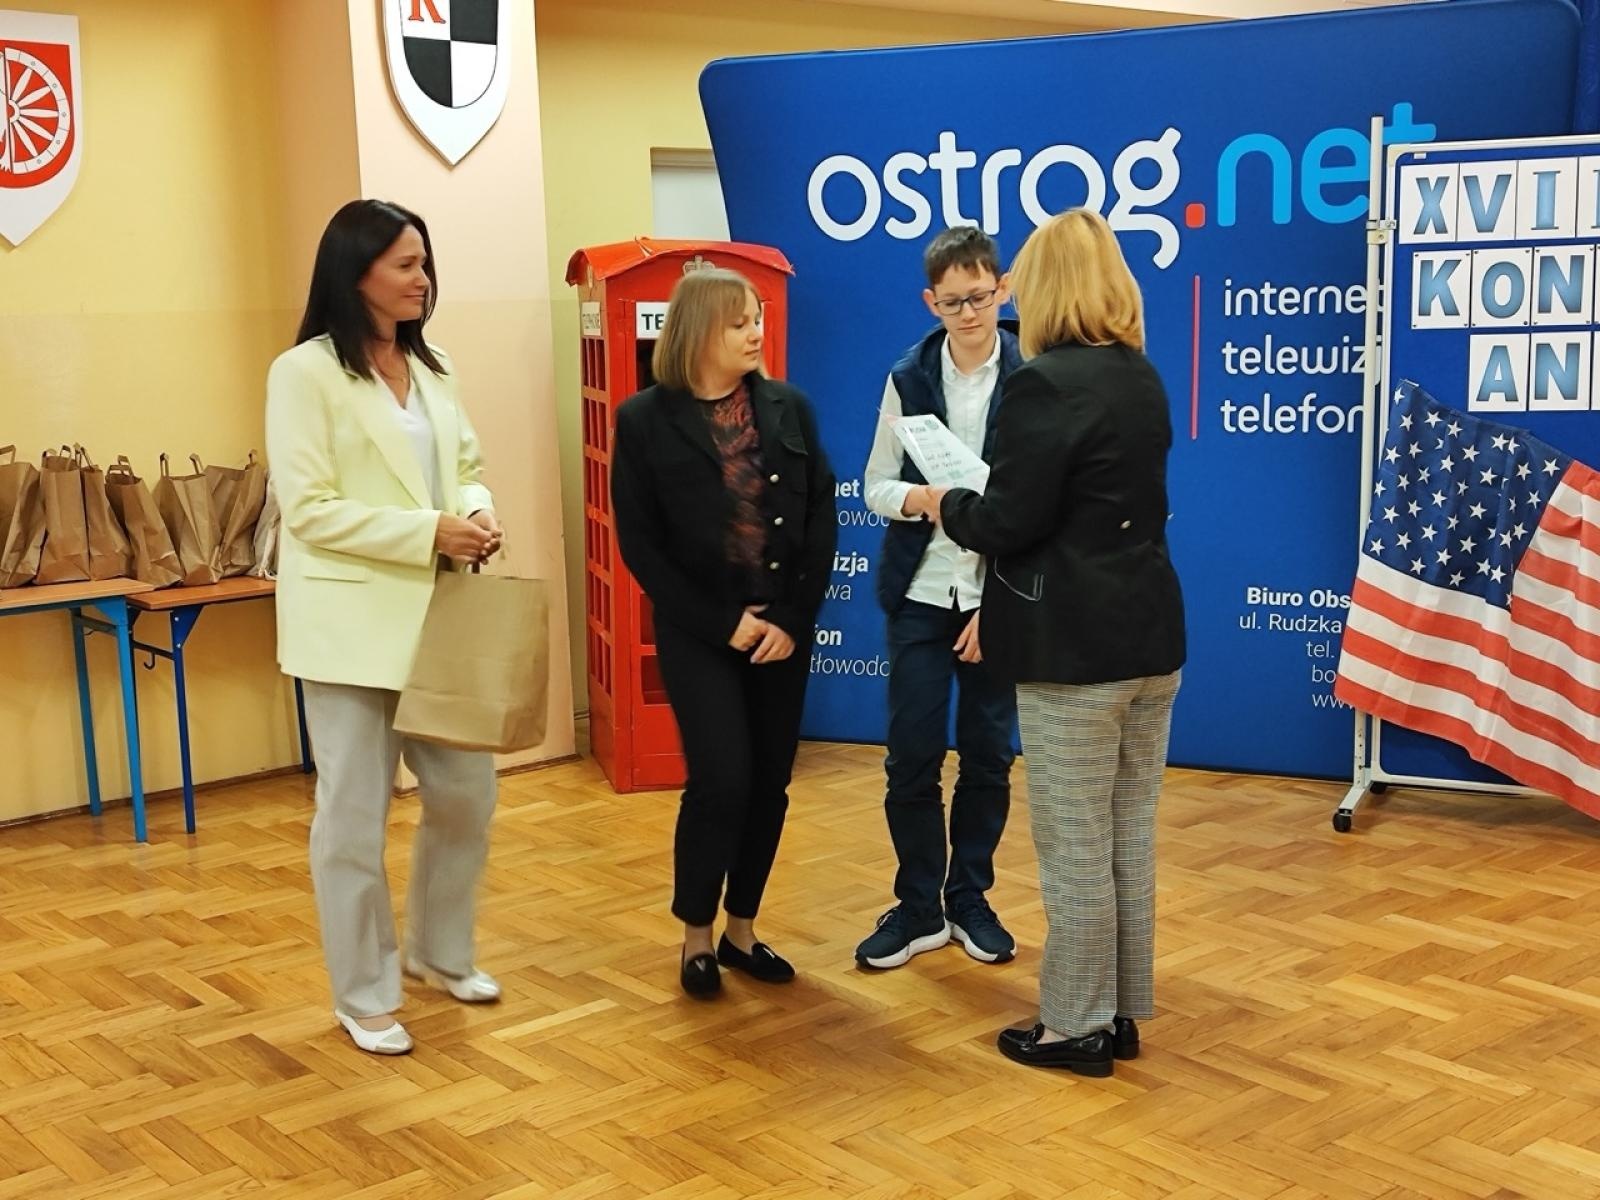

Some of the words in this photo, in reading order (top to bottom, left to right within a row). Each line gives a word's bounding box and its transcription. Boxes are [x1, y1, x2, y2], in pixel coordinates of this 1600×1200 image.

[1413, 169, 1600, 235] XVI
[1224, 279, 1384, 316] interne
[1418, 255, 1585, 319] KON
[1476, 342, 1581, 402] AN
[1247, 587, 1303, 606] Biuro
[1309, 589, 1351, 609] Obs
[1239, 612, 1262, 630] ul.
[1269, 614, 1342, 634] Rudzka
[1306, 641, 1335, 659] tel.
